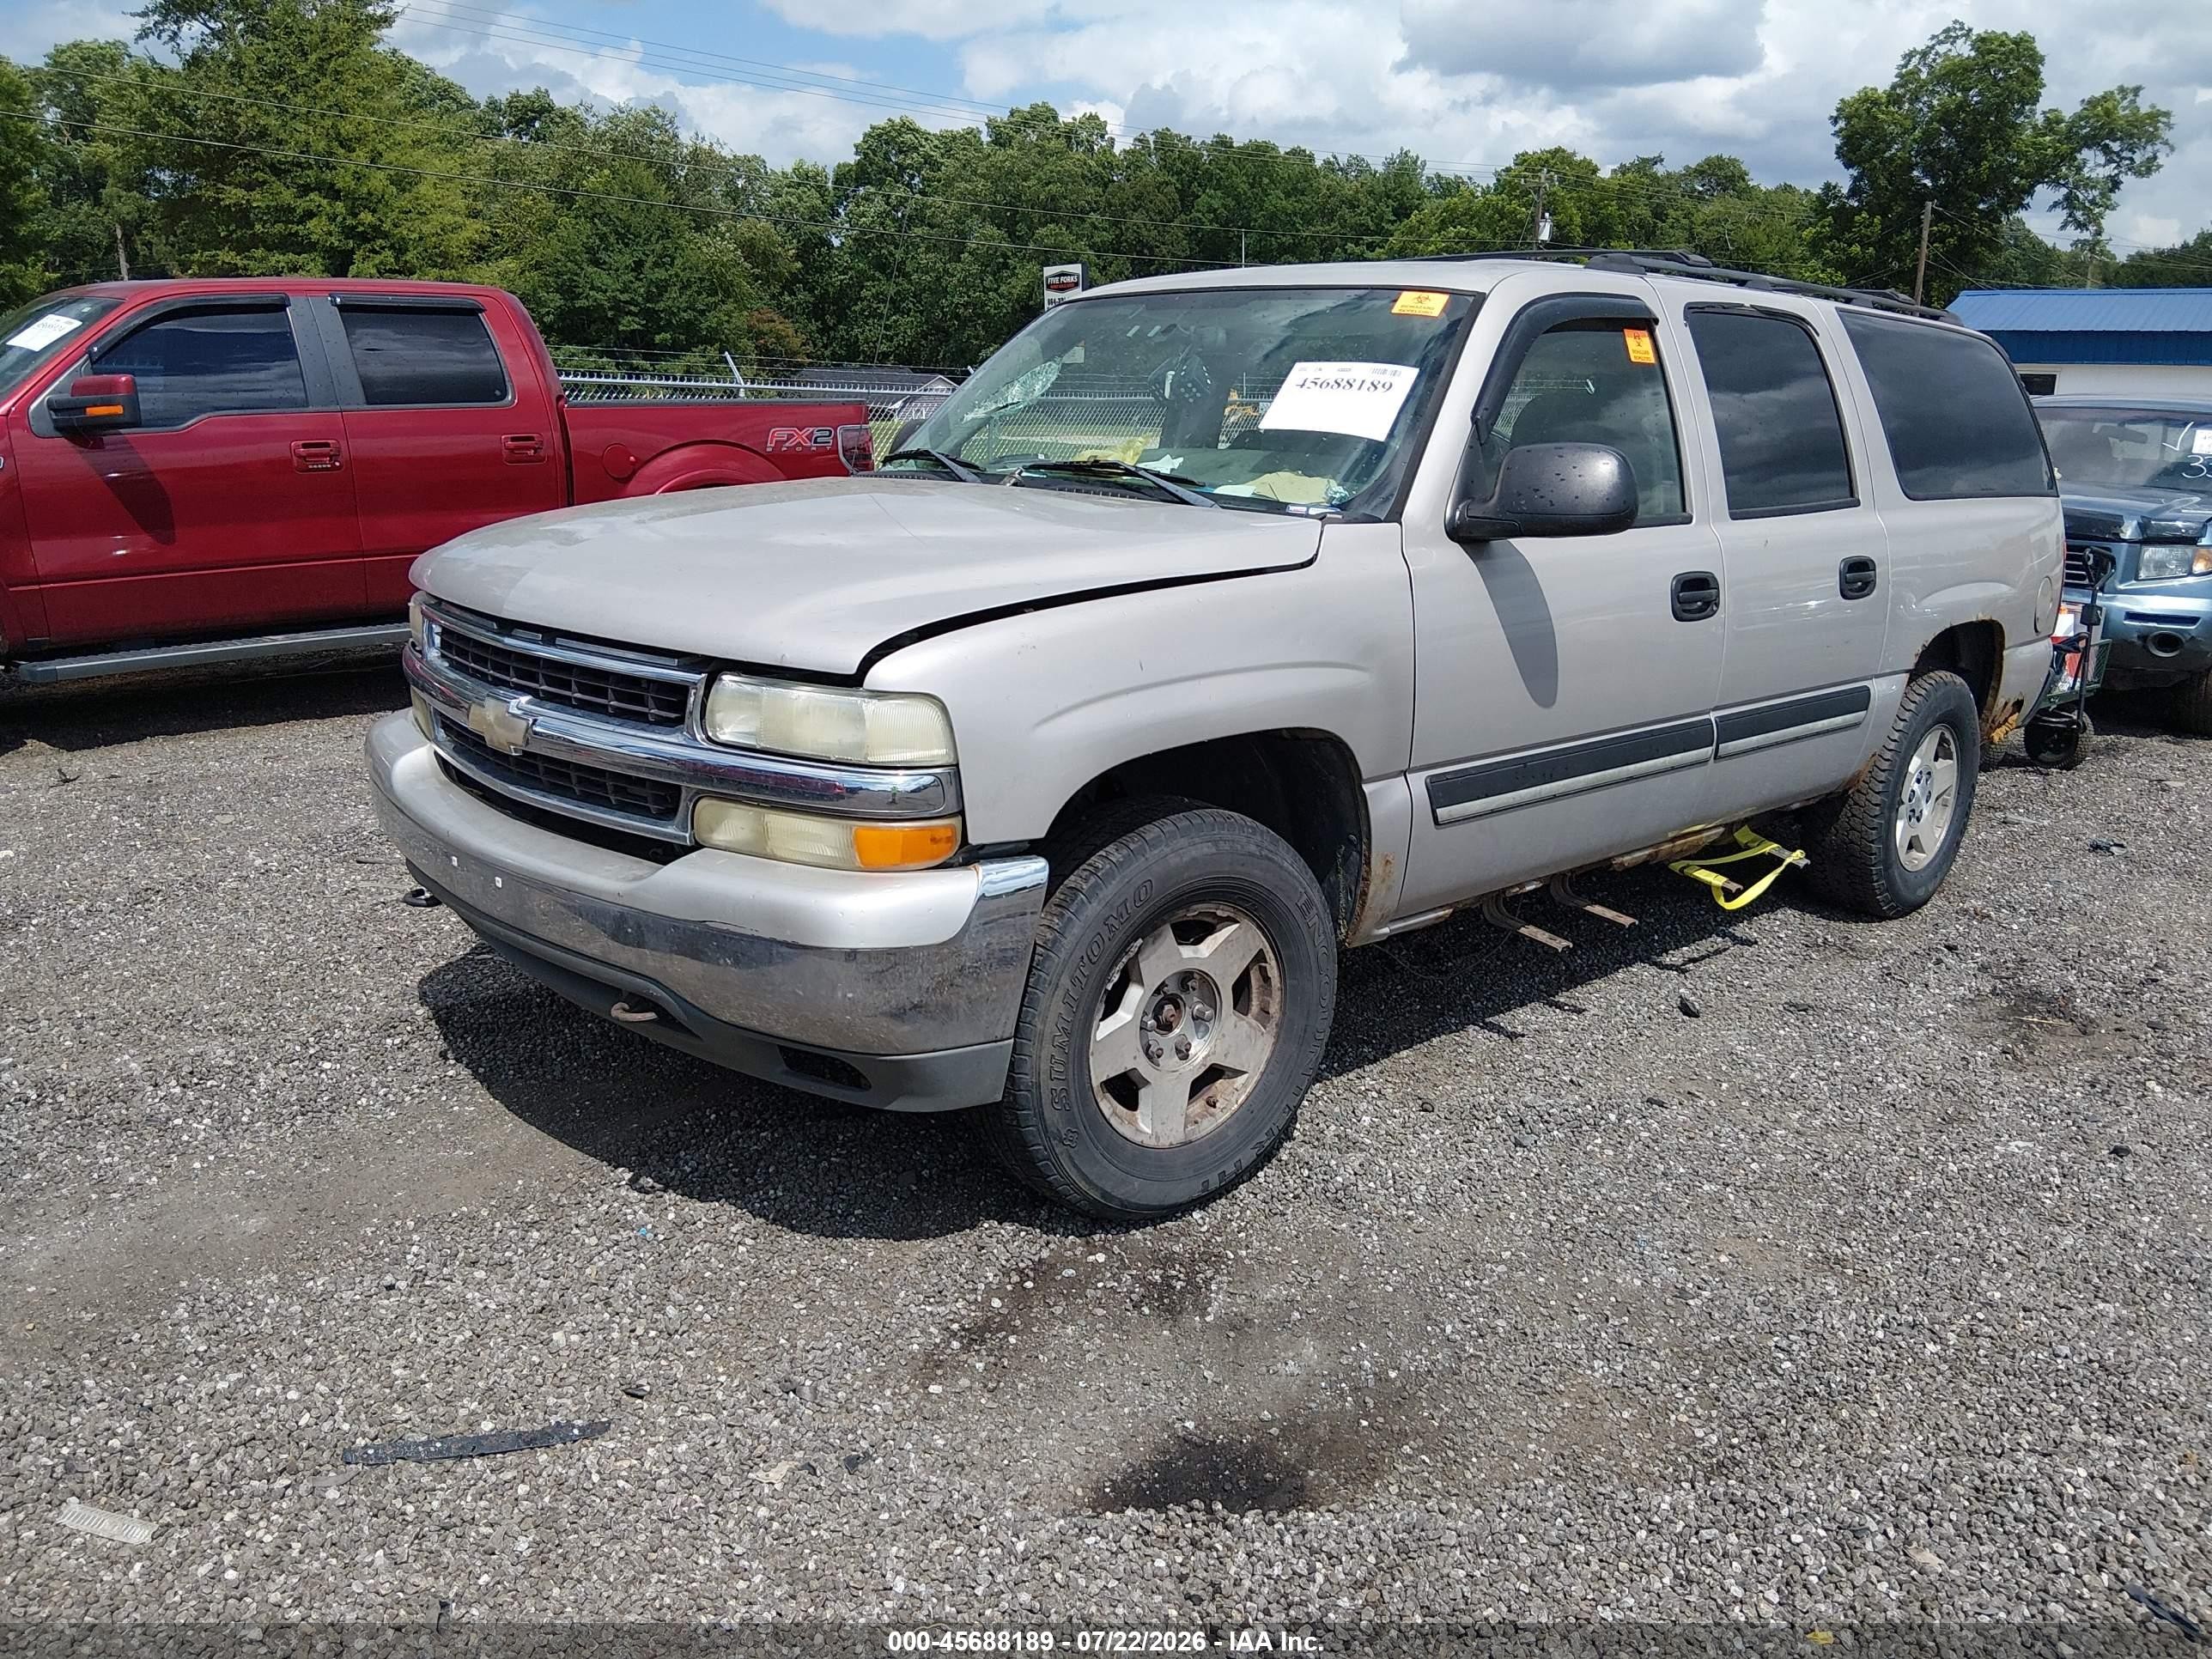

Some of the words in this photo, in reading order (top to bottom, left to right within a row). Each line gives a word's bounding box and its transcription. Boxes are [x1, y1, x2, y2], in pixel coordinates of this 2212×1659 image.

[1060, 275, 1078, 283] FORKS
[1295, 377, 1393, 393] 45688189
[767, 427, 834, 447] FX2
[1049, 878, 1153, 1112] SUMITOMO
